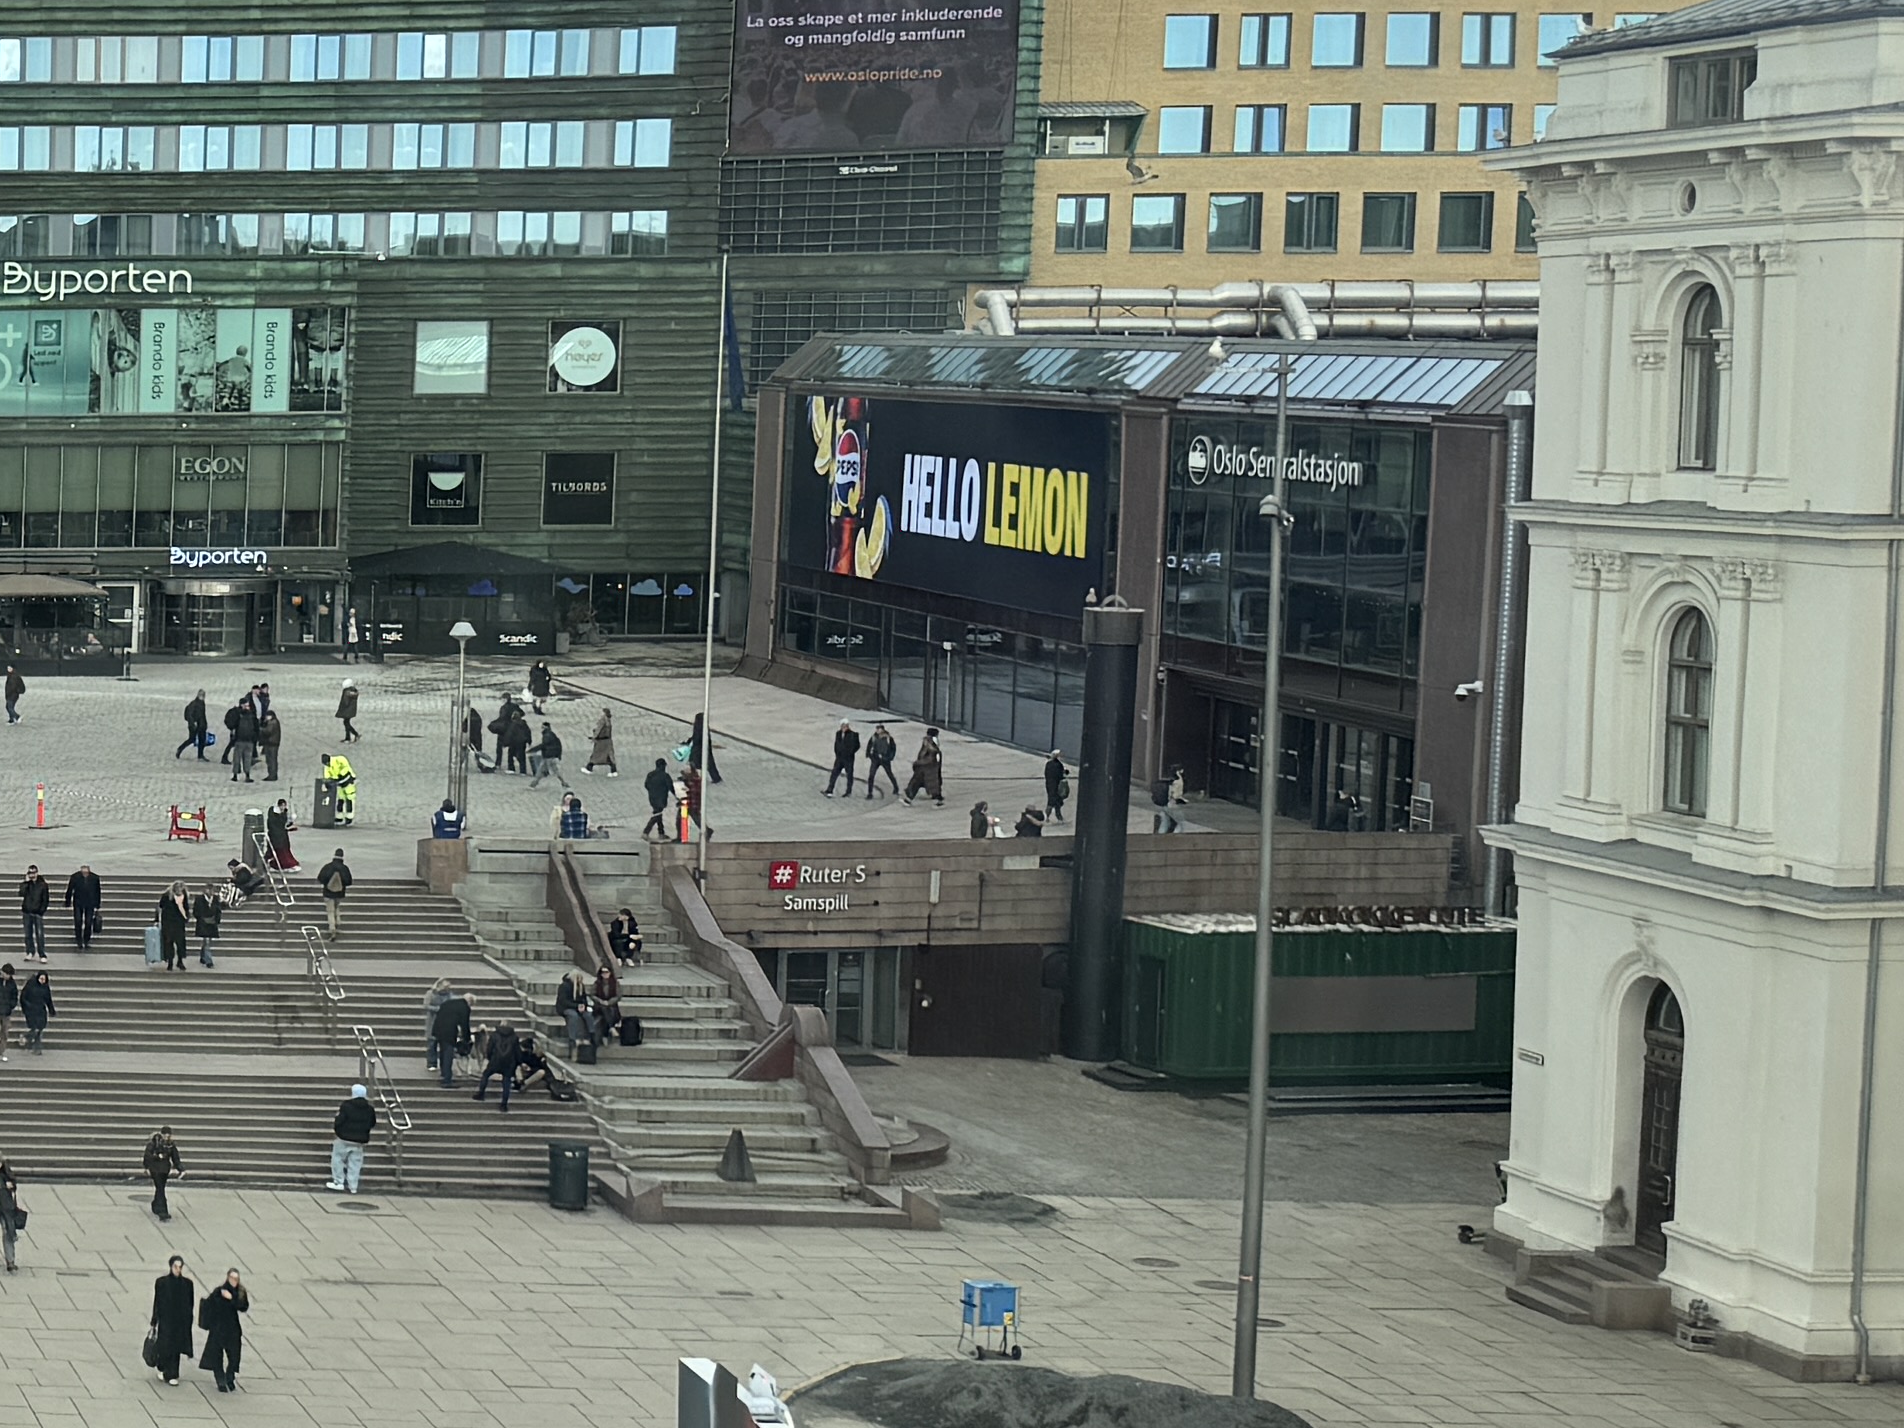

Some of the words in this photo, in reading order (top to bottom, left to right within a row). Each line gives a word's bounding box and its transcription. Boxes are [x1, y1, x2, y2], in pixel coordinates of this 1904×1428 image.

[746, 16, 764, 28] La
[768, 16, 794, 28] oss
[798, 13, 843, 30] skape
[848, 12, 863, 24] et
[868, 11, 897, 23] mer
[901, 6, 1003, 22] inkluderende
[784, 33, 804, 47] og
[808, 29, 895, 46] mangfoldig
[899, 27, 966, 41] samfunn
[804, 67, 943, 83] www.oslopride.no
[3, 261, 193, 301] Byporten
[152, 322, 165, 371] Brando
[265, 322, 278, 371] Brando
[151, 375, 165, 400] kids
[263, 374, 275, 399] kids
[179, 457, 246, 474] EGON
[1213, 445, 1245, 476] Oslo
[1248, 446, 1362, 492] Senralstasjon
[901, 453, 981, 542] HELLO
[984, 461, 1089, 559] LEMON
[170, 547, 267, 568] Byporten
[800, 865, 850, 884] Ruter
[855, 865, 866, 883] S
[784, 894, 849, 914] Samspill
